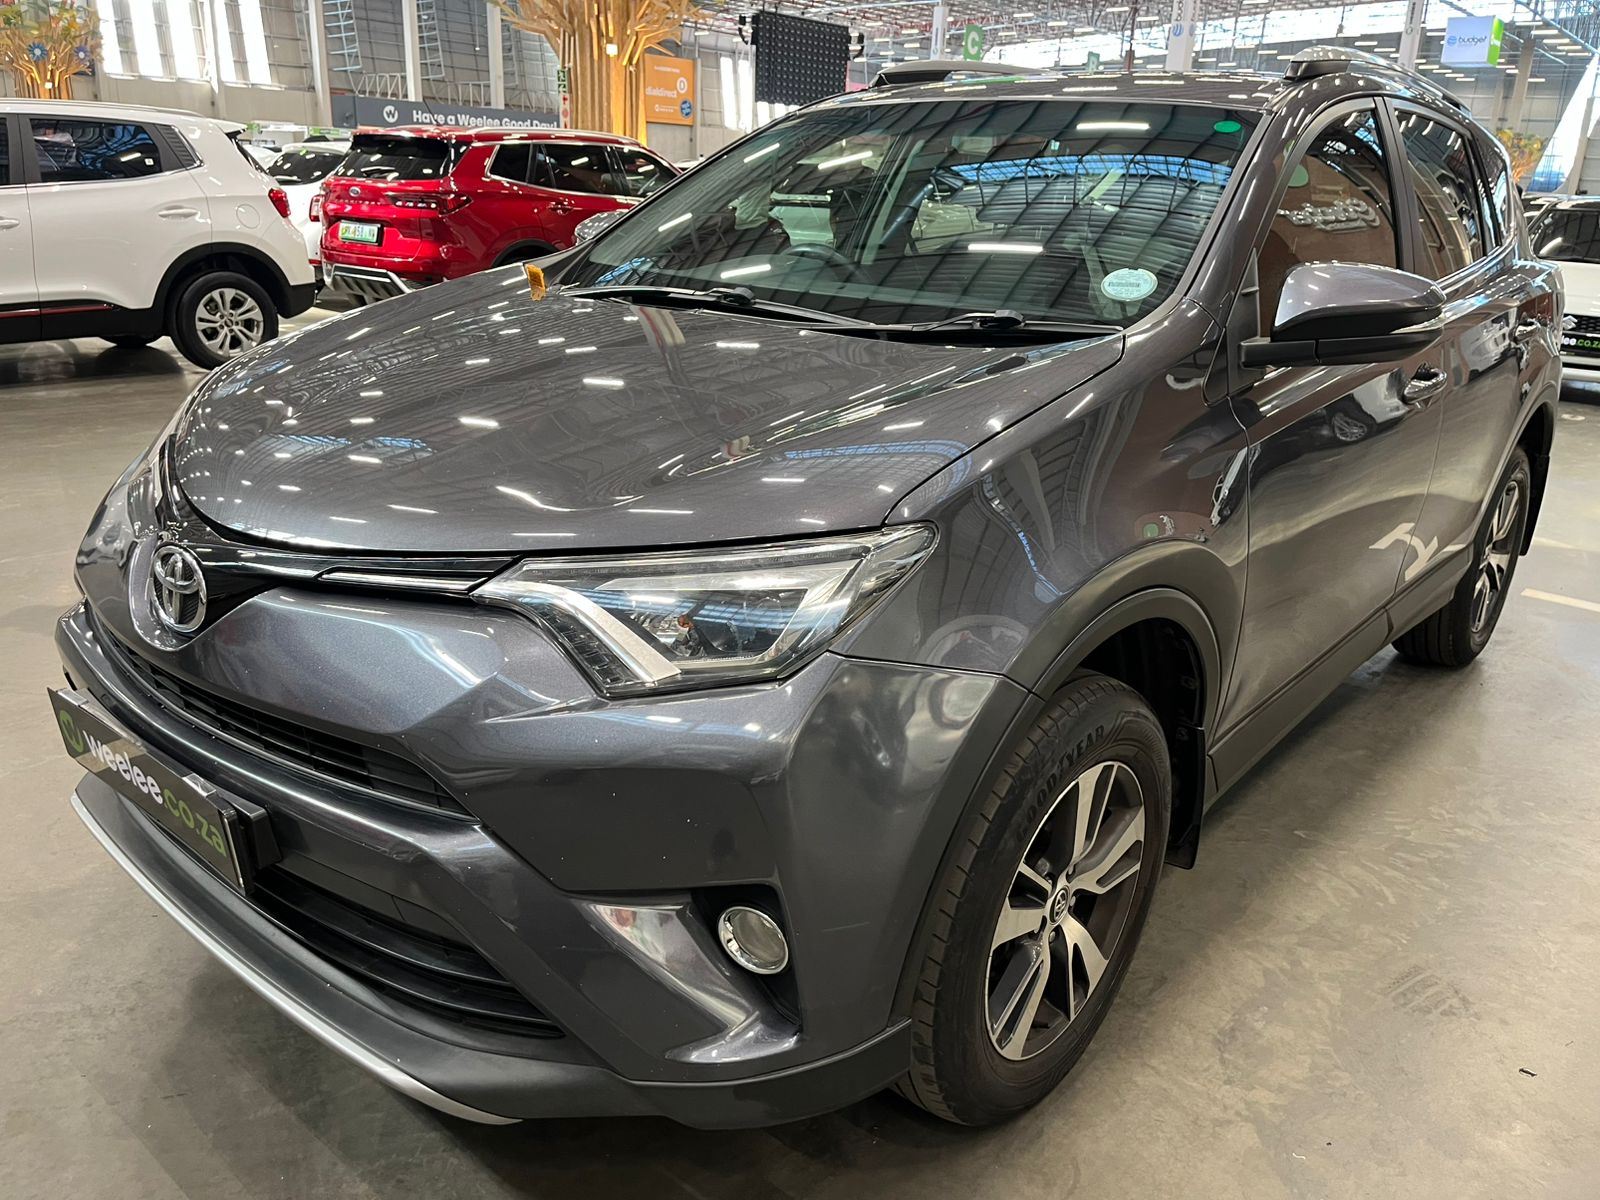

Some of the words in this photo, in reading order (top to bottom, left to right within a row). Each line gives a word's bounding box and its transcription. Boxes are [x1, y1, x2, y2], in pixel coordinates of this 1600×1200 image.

[967, 31, 980, 55] C
[412, 110, 445, 125] Have
[446, 114, 456, 125] a
[457, 114, 501, 127] Weelee
[502, 118, 531, 128] Good
[82, 730, 227, 857] weelee.co.za
